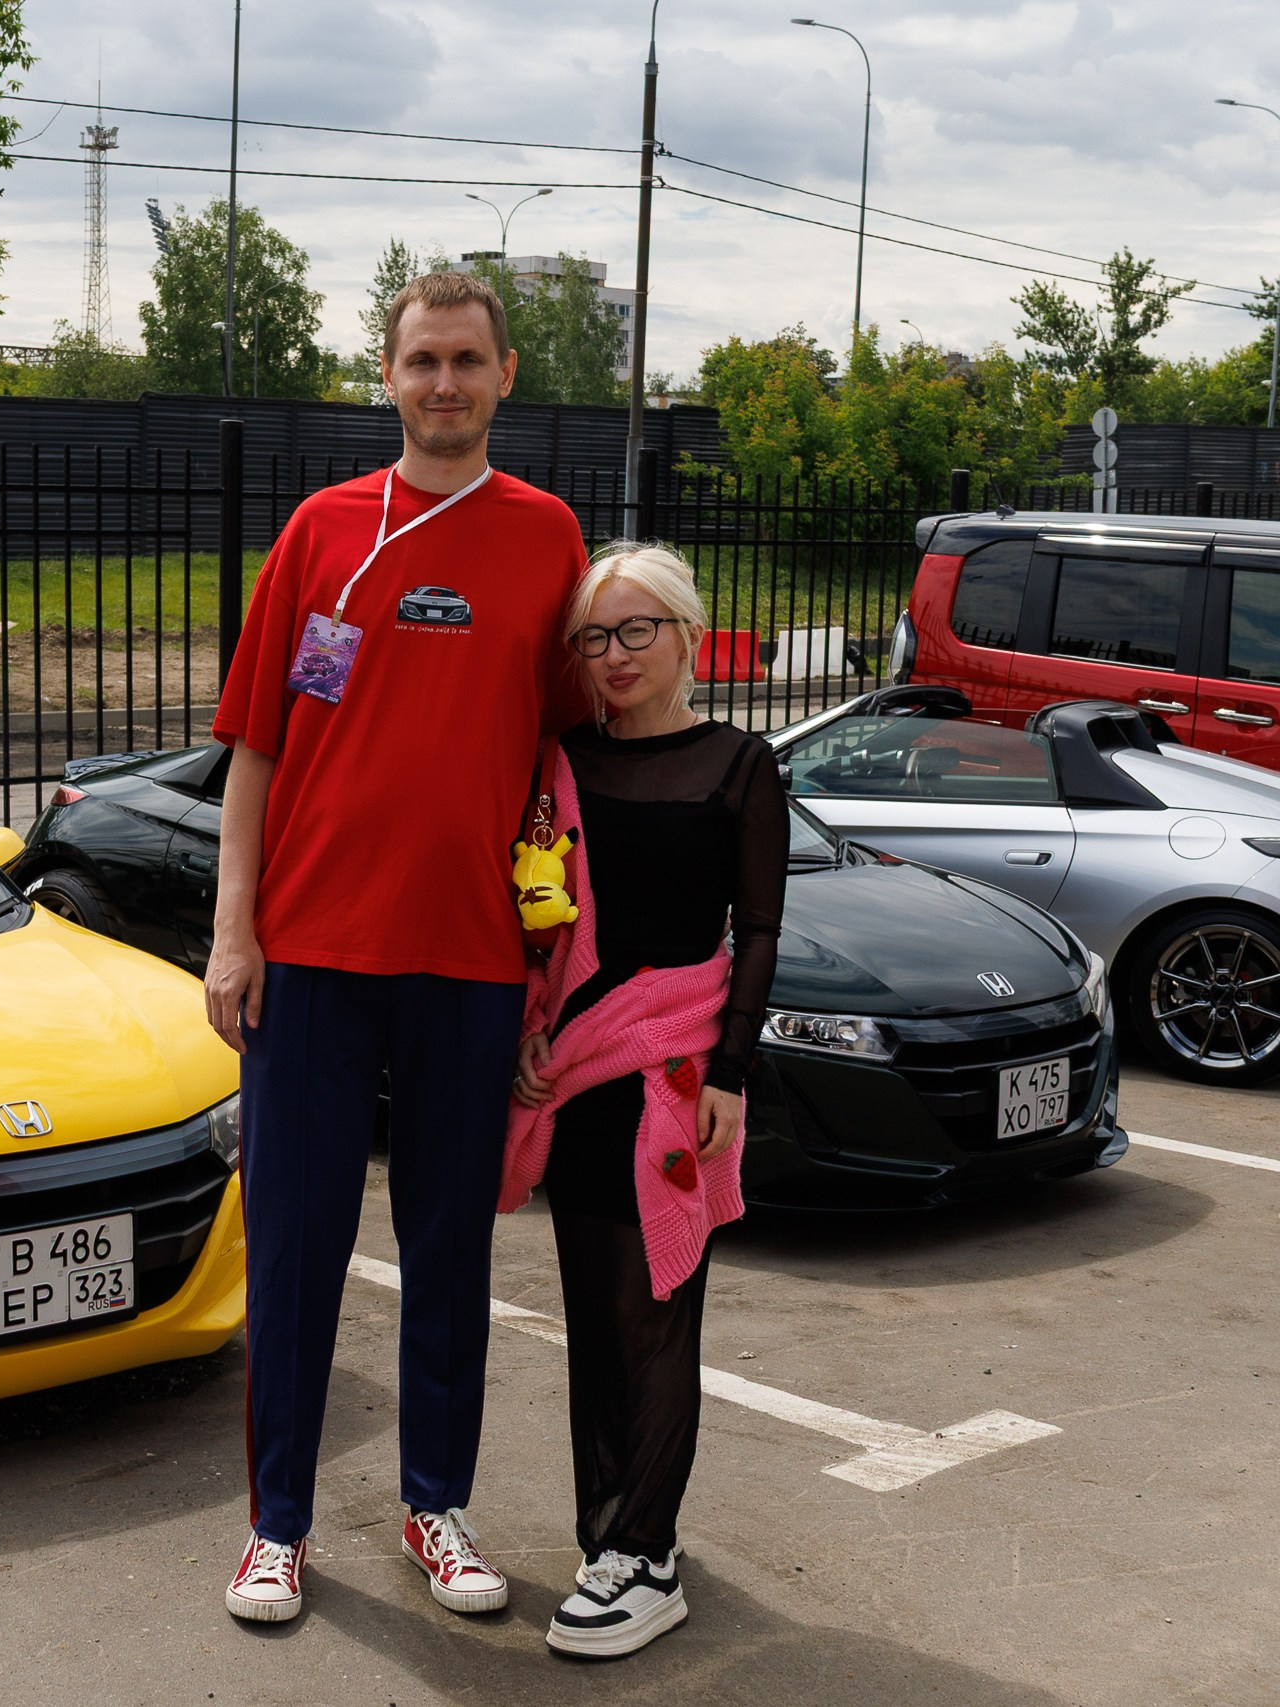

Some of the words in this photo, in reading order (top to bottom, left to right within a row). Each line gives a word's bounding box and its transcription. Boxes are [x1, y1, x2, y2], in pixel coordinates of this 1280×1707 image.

[1009, 1070, 1021, 1098] K
[1028, 1062, 1060, 1093] 475
[1003, 1104, 1030, 1134] XO
[1039, 1094, 1065, 1119] 797
[11, 1238, 34, 1276] B
[49, 1224, 111, 1267] 486
[3, 1283, 54, 1328] EP
[75, 1268, 123, 1303] 323
[87, 1298, 110, 1312] RUS
